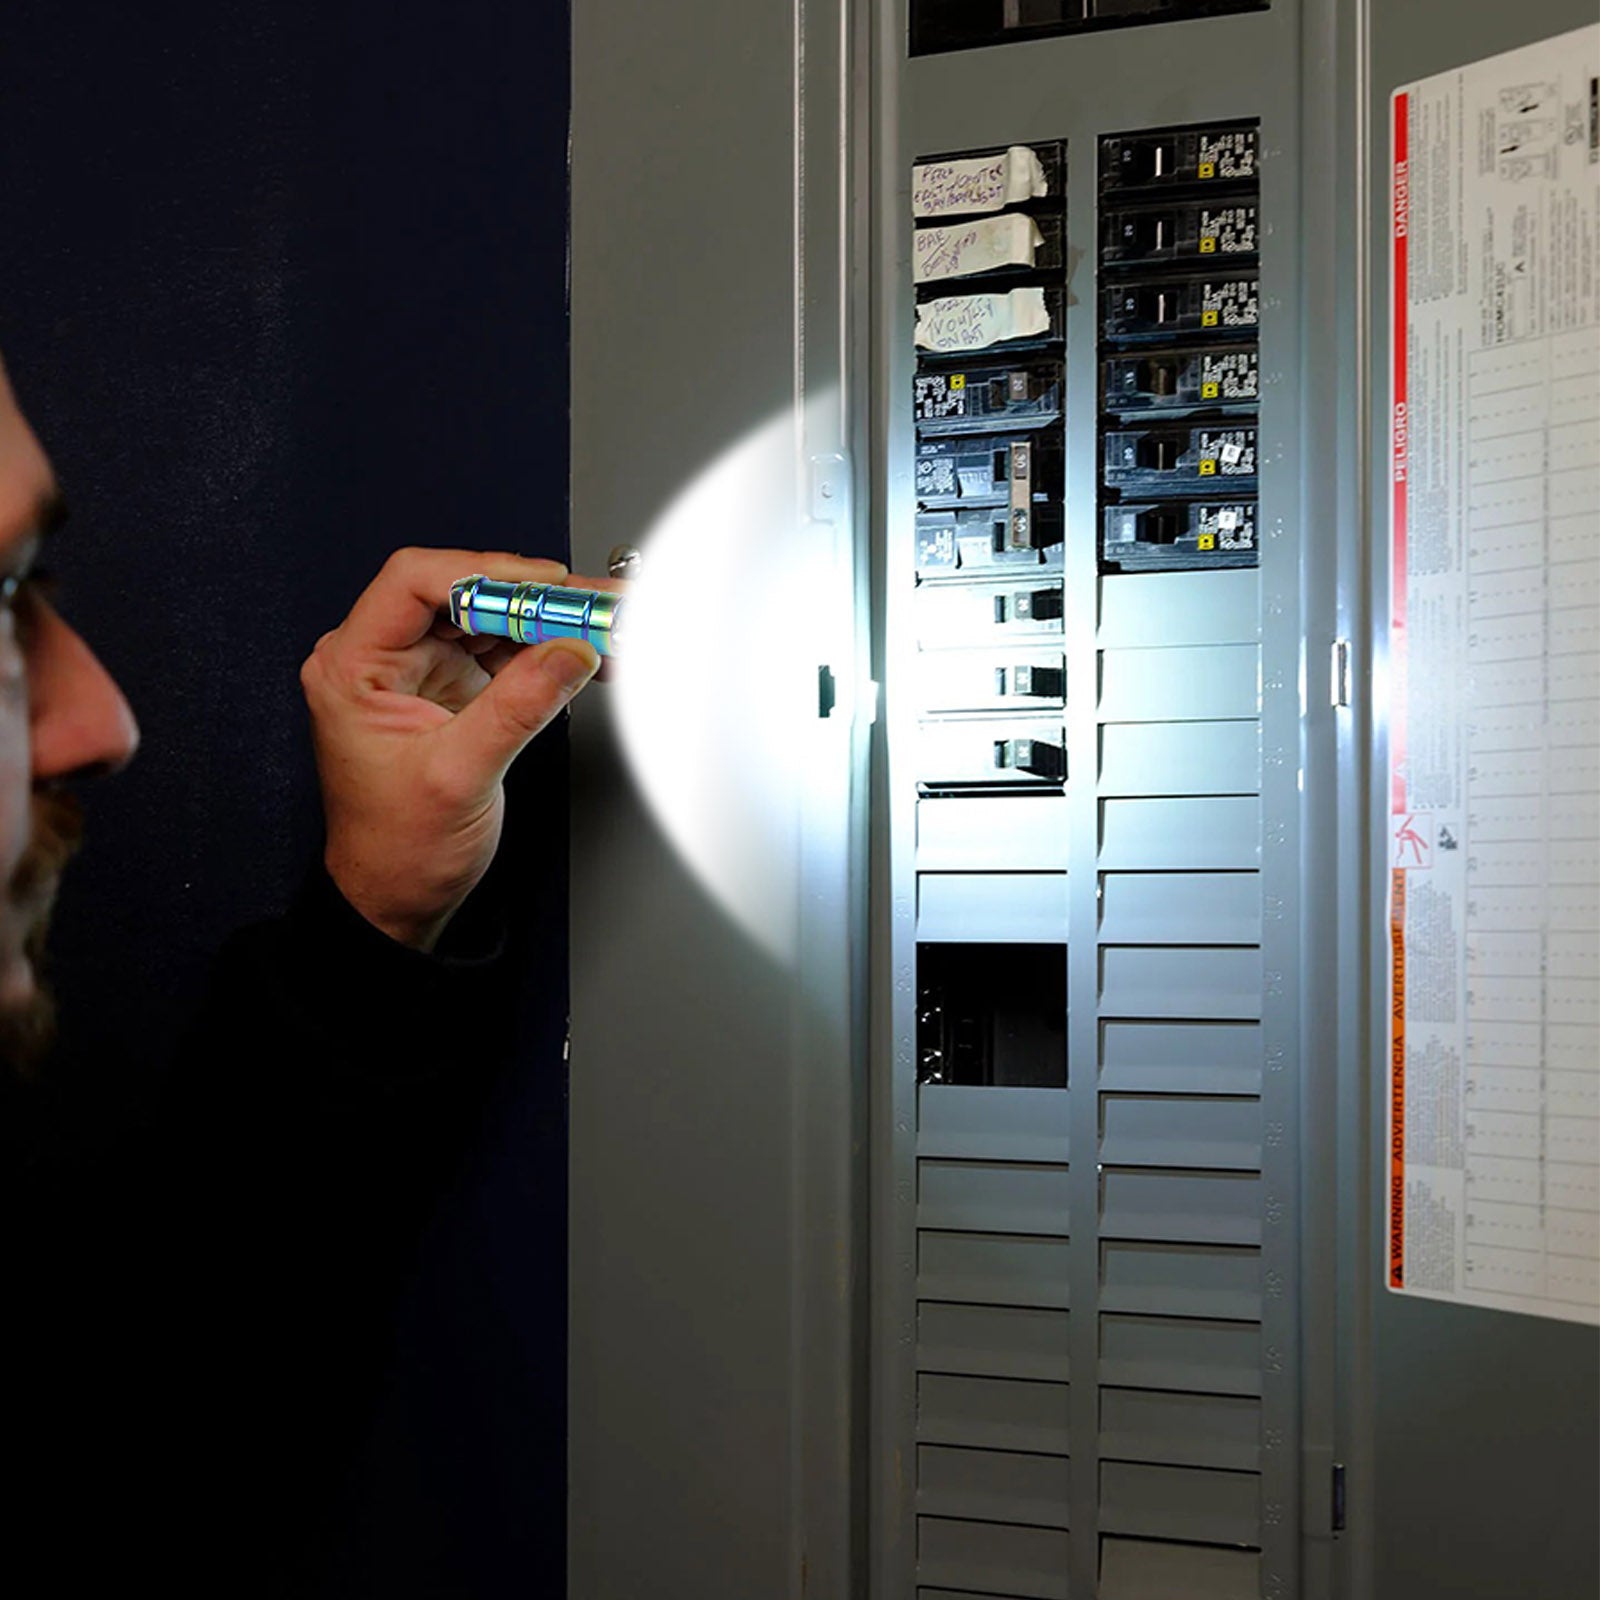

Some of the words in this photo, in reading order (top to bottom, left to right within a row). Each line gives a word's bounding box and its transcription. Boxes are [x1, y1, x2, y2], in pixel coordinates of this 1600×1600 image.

[1395, 160, 1407, 237] DANGER
[1016, 453, 1026, 468] 30
[1394, 402, 1407, 482] PELIGRO
[1392, 1036, 1404, 1162] ADVERTENCIA
[1391, 1175, 1404, 1260] WARNING
